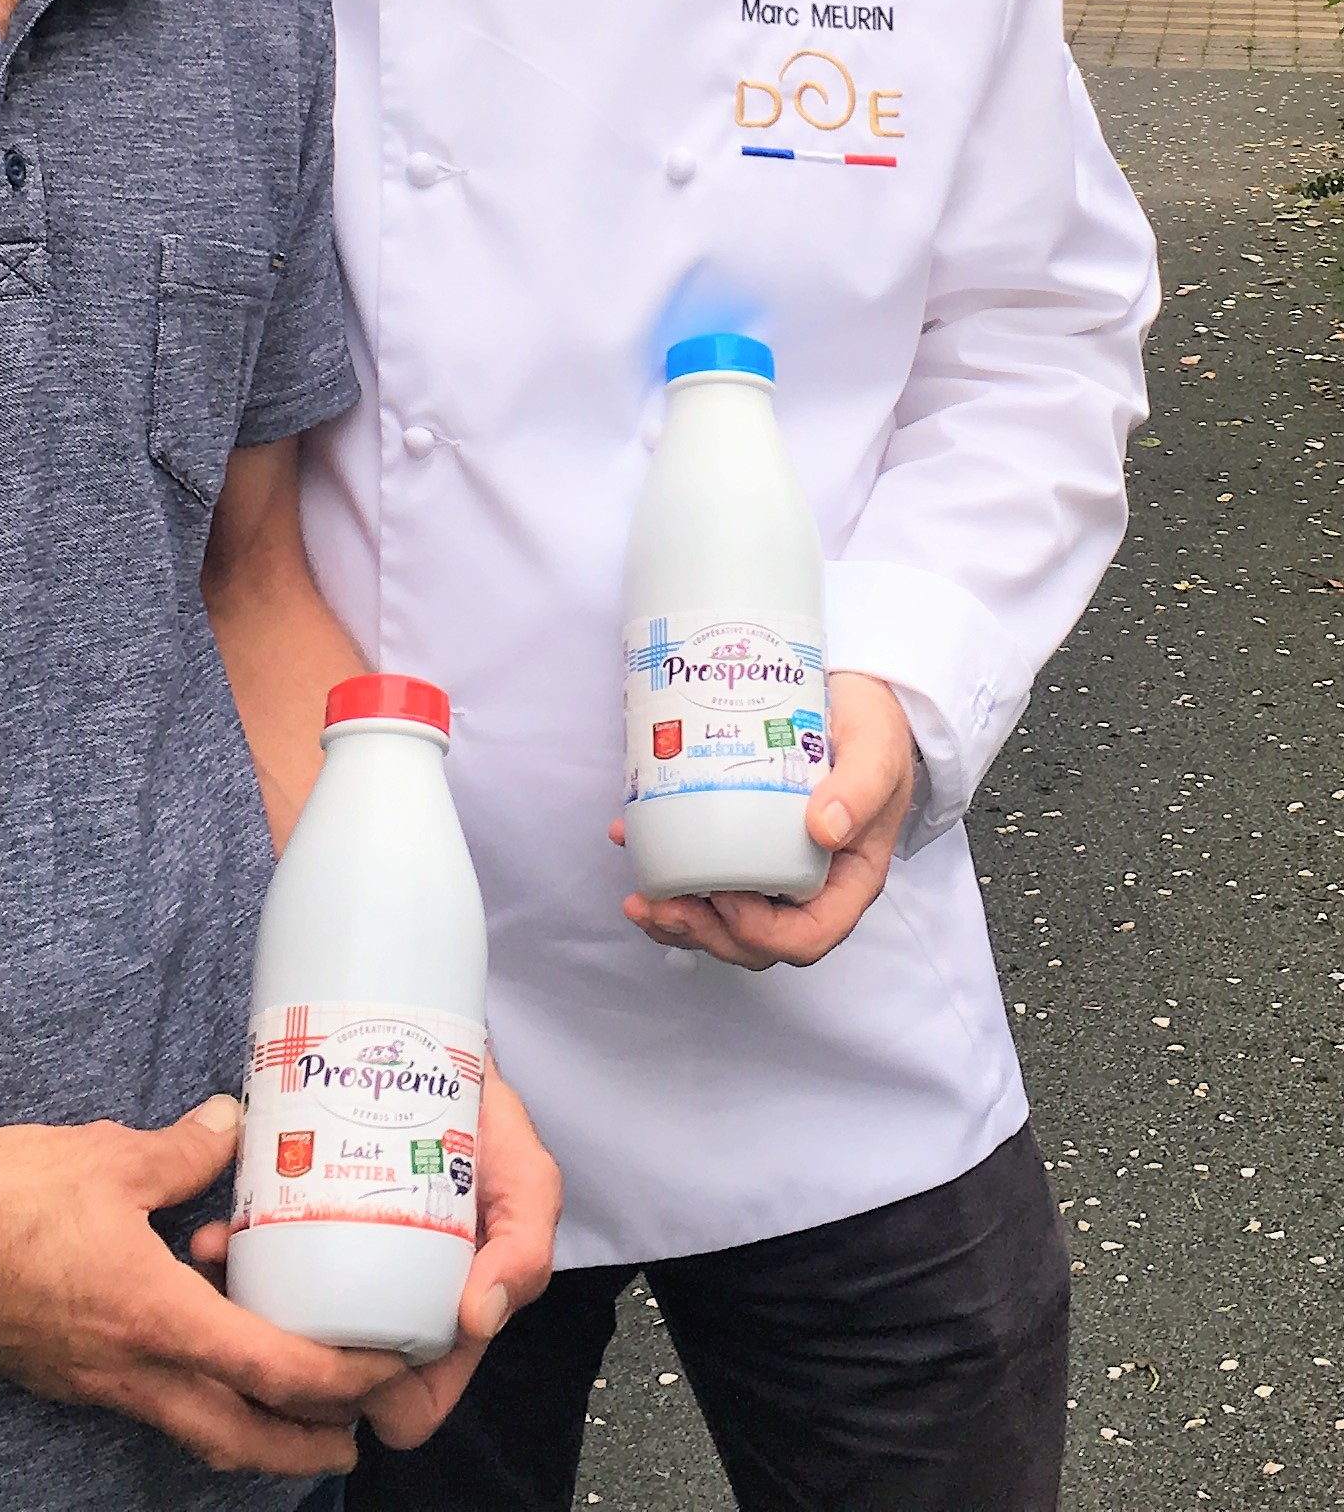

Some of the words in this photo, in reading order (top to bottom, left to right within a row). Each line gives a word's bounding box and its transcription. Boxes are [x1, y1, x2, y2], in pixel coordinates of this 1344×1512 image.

[811, 2, 894, 32] MEURIN
[662, 654, 806, 690] Prospérité
[705, 723, 741, 740] Lait
[297, 1053, 462, 1101] Prospérité
[339, 1138, 386, 1160] Lait
[322, 1163, 398, 1183] ENTIER
